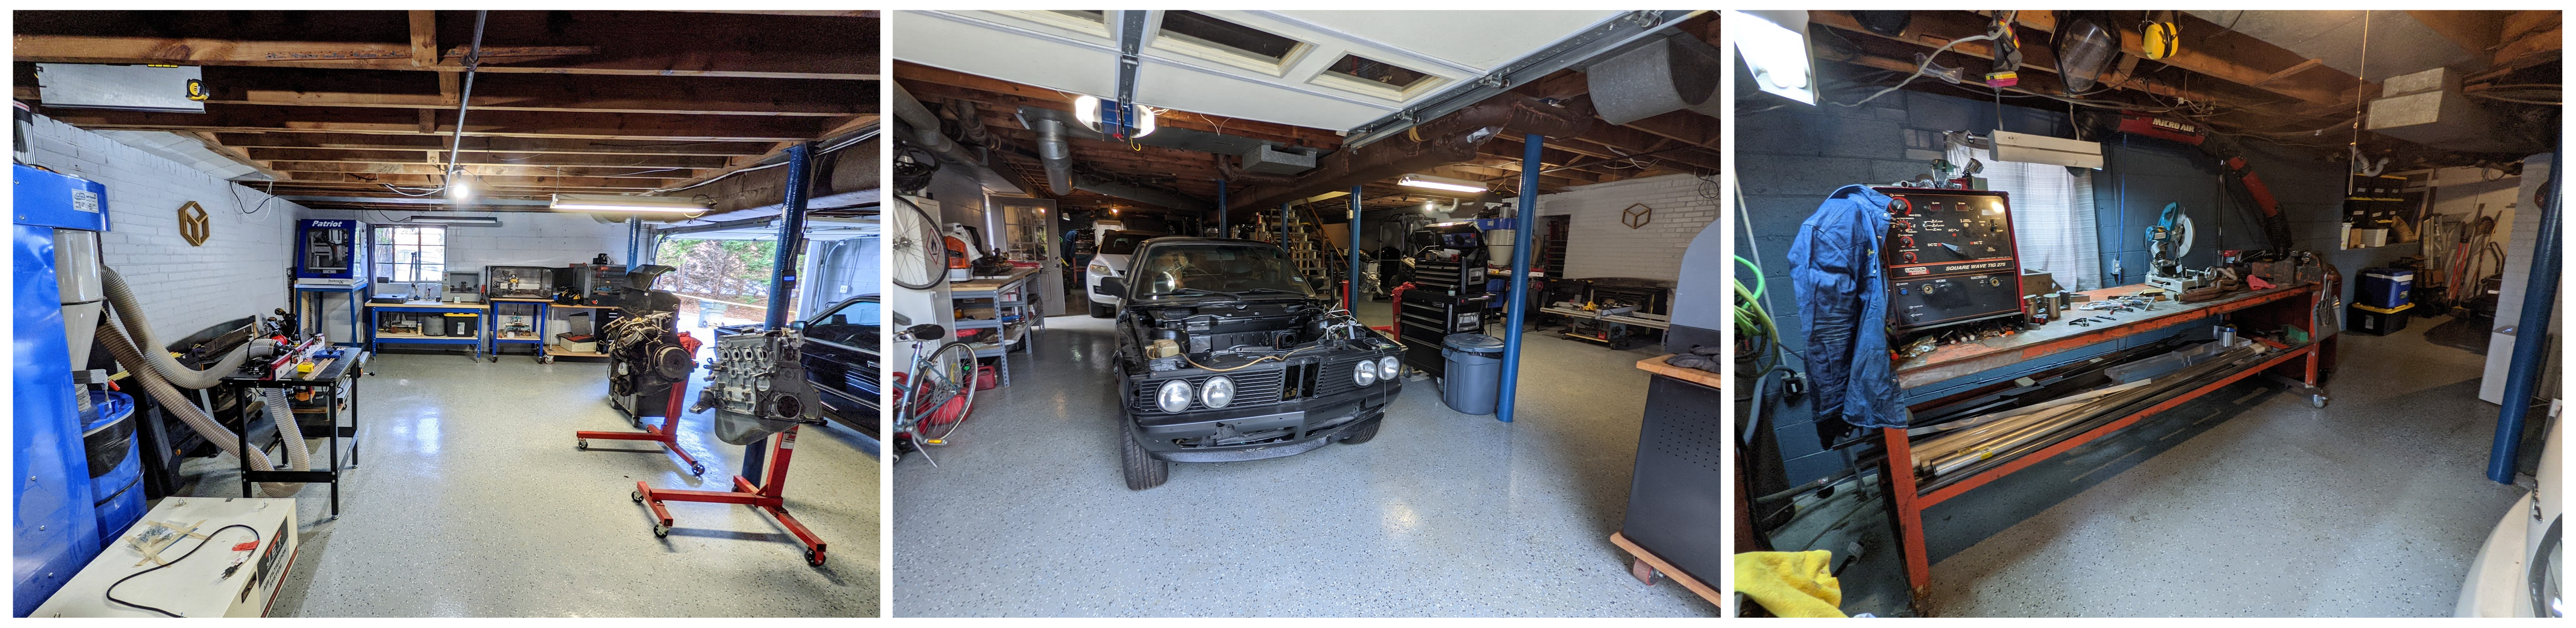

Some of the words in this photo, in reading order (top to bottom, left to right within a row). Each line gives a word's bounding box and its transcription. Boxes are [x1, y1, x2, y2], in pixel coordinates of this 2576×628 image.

[2152, 118, 2180, 129] MICRO
[2180, 124, 2195, 132] AIR
[266, 533, 282, 567] JET
[269, 547, 286, 580] FILTRATION
[270, 563, 282, 588] SYSTEM
